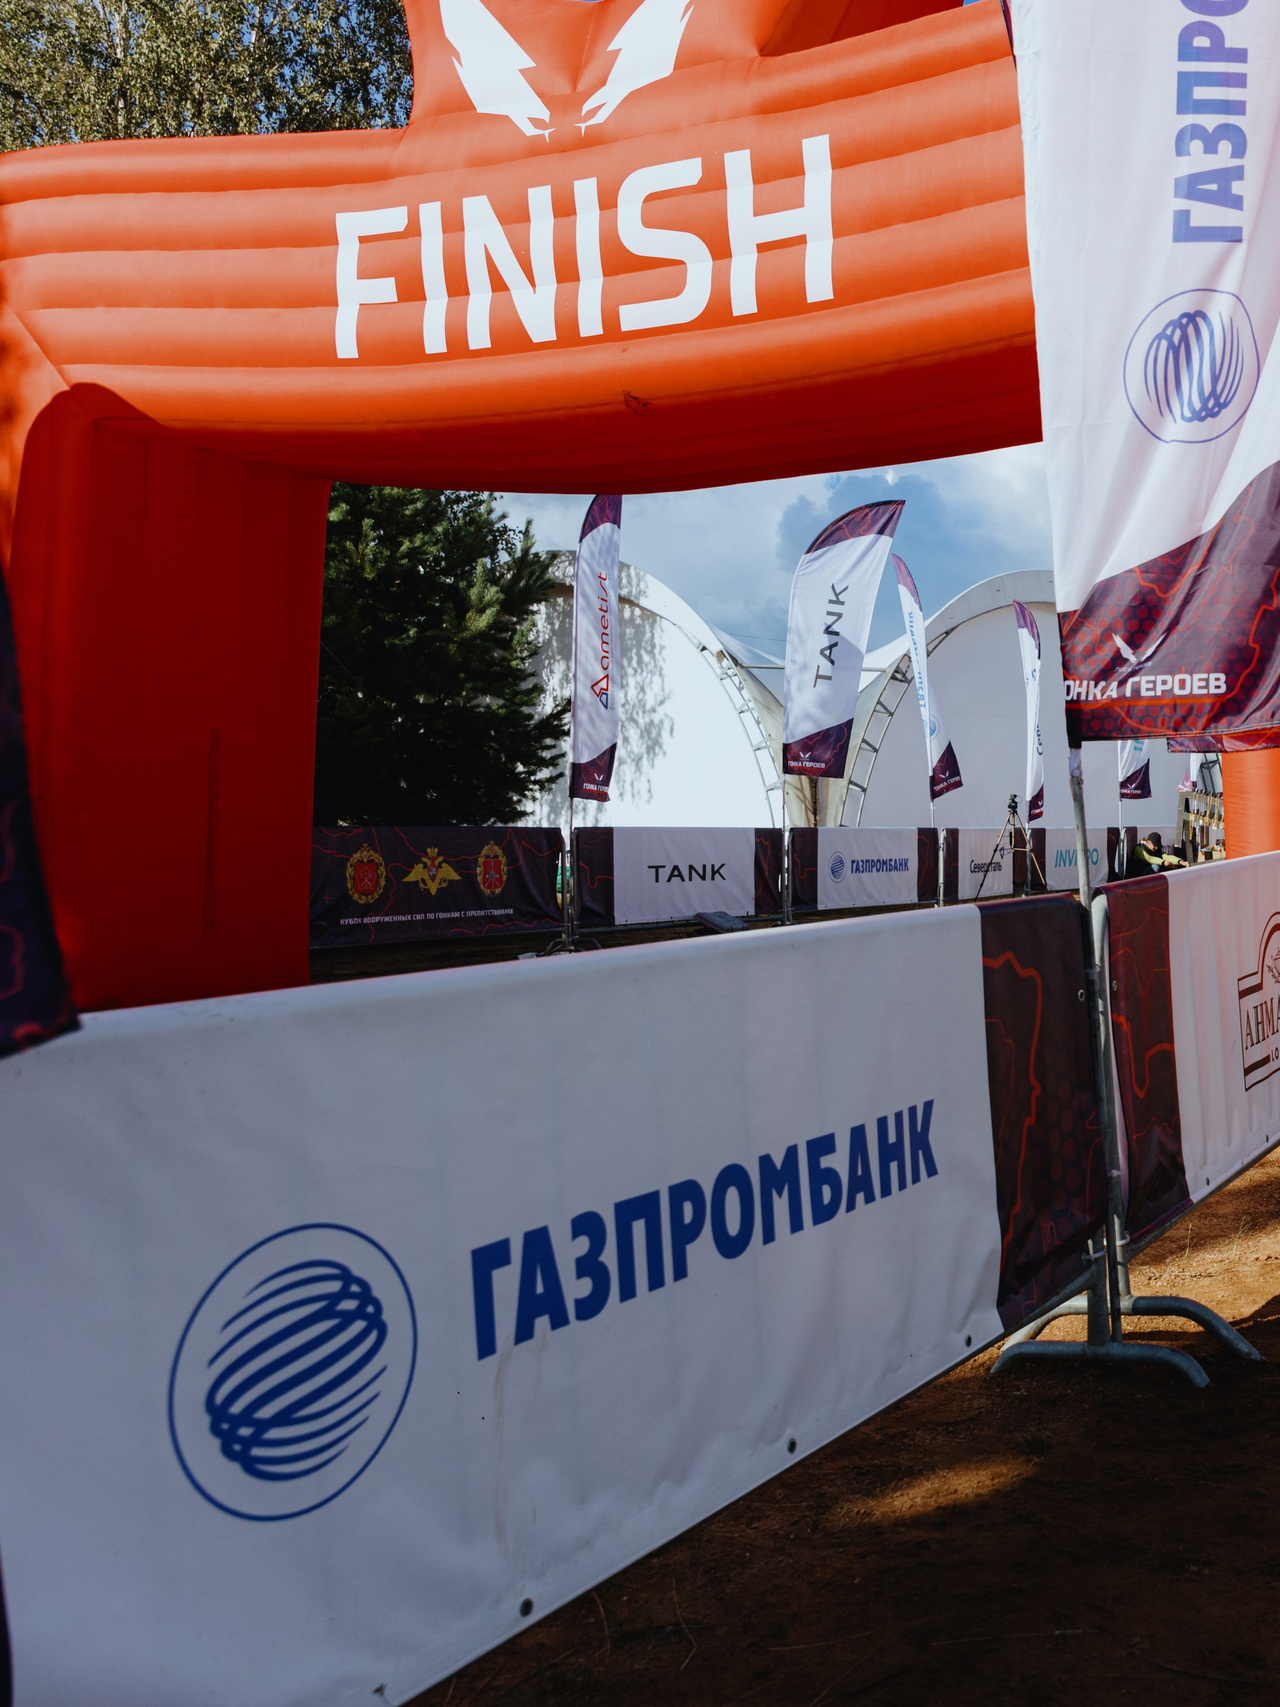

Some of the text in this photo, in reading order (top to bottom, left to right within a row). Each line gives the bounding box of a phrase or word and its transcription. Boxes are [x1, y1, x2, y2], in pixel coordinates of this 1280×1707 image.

[335, 133, 835, 359] FINISH
[813, 583, 849, 688] TANK
[1064, 672, 1227, 701] ОНКА ГЕРОЕВ
[647, 863, 726, 883] TANK
[850, 857, 910, 874] ГАЗПРОМБАНК
[969, 859, 1003, 873] Северталь
[340, 917, 362, 925] КУБОК
[363, 914, 412, 924] ВООРУЖЕННЫХ
[412, 913, 425, 921] СИЛ
[426, 912, 435, 920] ПО
[435, 910, 460, 919] ГОНКАМ
[466, 908, 514, 917] ПРЕПЯТСТВИЯМИ
[470, 1098, 939, 1361] ГАЗПРОМБАНК
